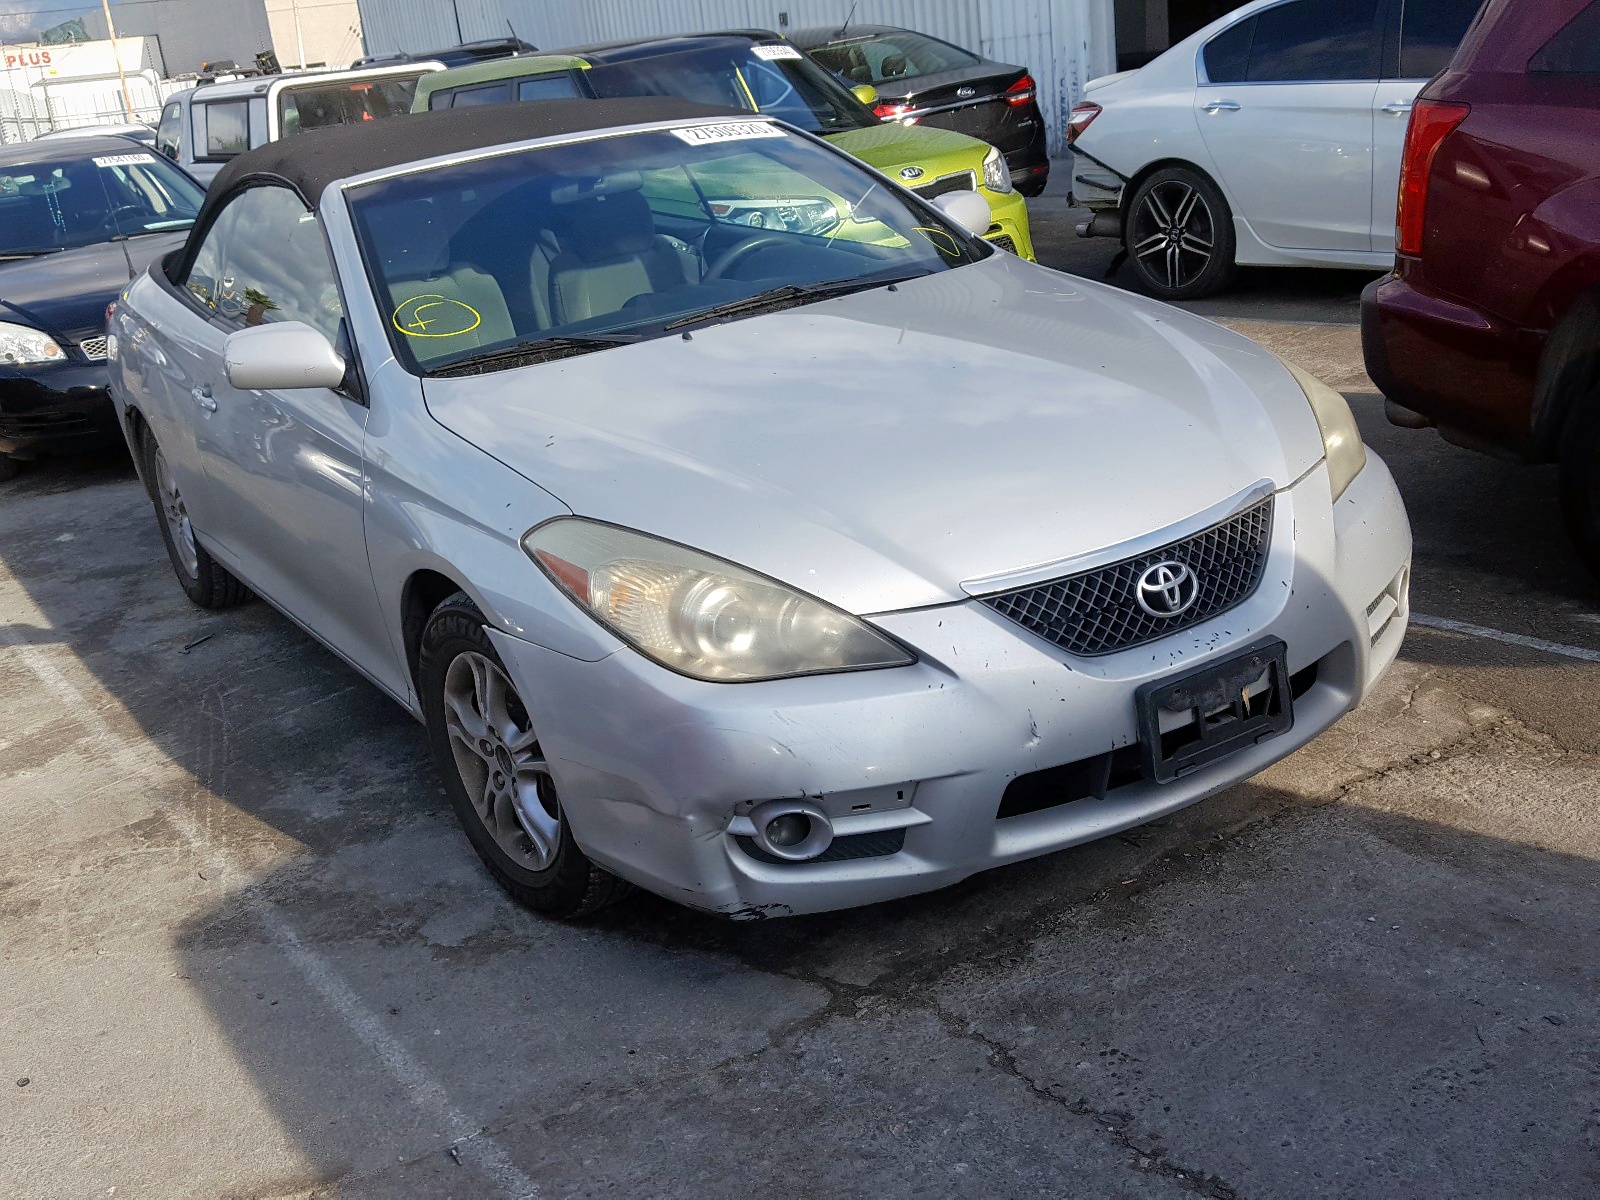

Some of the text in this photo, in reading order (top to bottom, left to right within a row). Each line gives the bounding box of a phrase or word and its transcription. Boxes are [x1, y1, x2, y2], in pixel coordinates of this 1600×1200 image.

[6, 51, 52, 68] PLUS
[686, 123, 769, 140] 27509320
[902, 167, 923, 178] KIA
